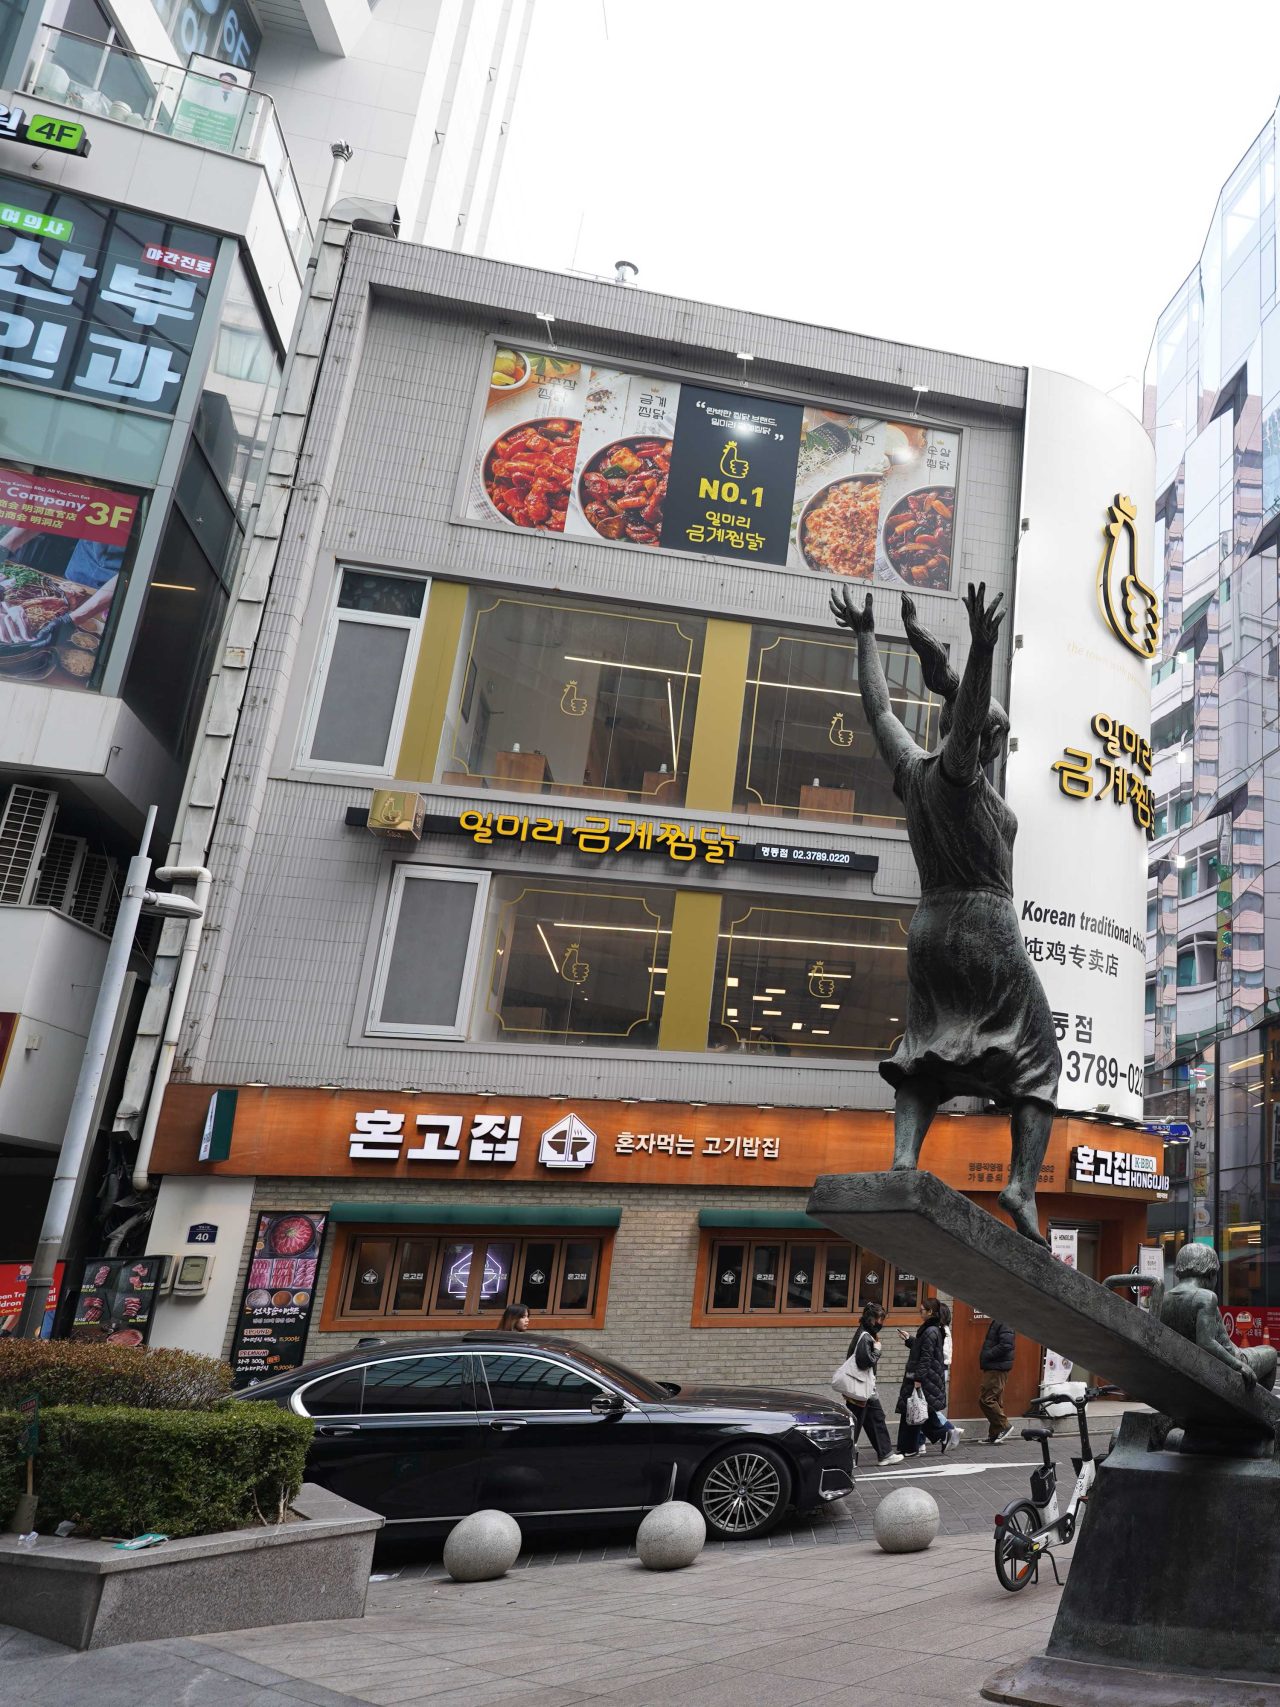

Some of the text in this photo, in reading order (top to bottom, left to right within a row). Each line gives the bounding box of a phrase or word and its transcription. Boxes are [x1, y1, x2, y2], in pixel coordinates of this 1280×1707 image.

[35, 122, 77, 143] 4F
[146, 247, 212, 274] 야간진료
[698, 477, 764, 508] NO.1
[7, 487, 133, 529] Company 3F
[705, 511, 751, 529] 일미리
[686, 524, 766, 551] 금계찜닭
[459, 809, 850, 864] 일미리 금계찜닭 명동점 02.3789.0220
[1021, 900, 1076, 928] Korean
[1080, 912, 1132, 946] traditional
[348, 1108, 781, 1163] 혼고집 혼자먹는 고기밥집
[1075, 1145, 1131, 1187] 혼고집
[1130, 1172, 1170, 1191] HONGOJIB
[195, 1232, 209, 1242] 40
